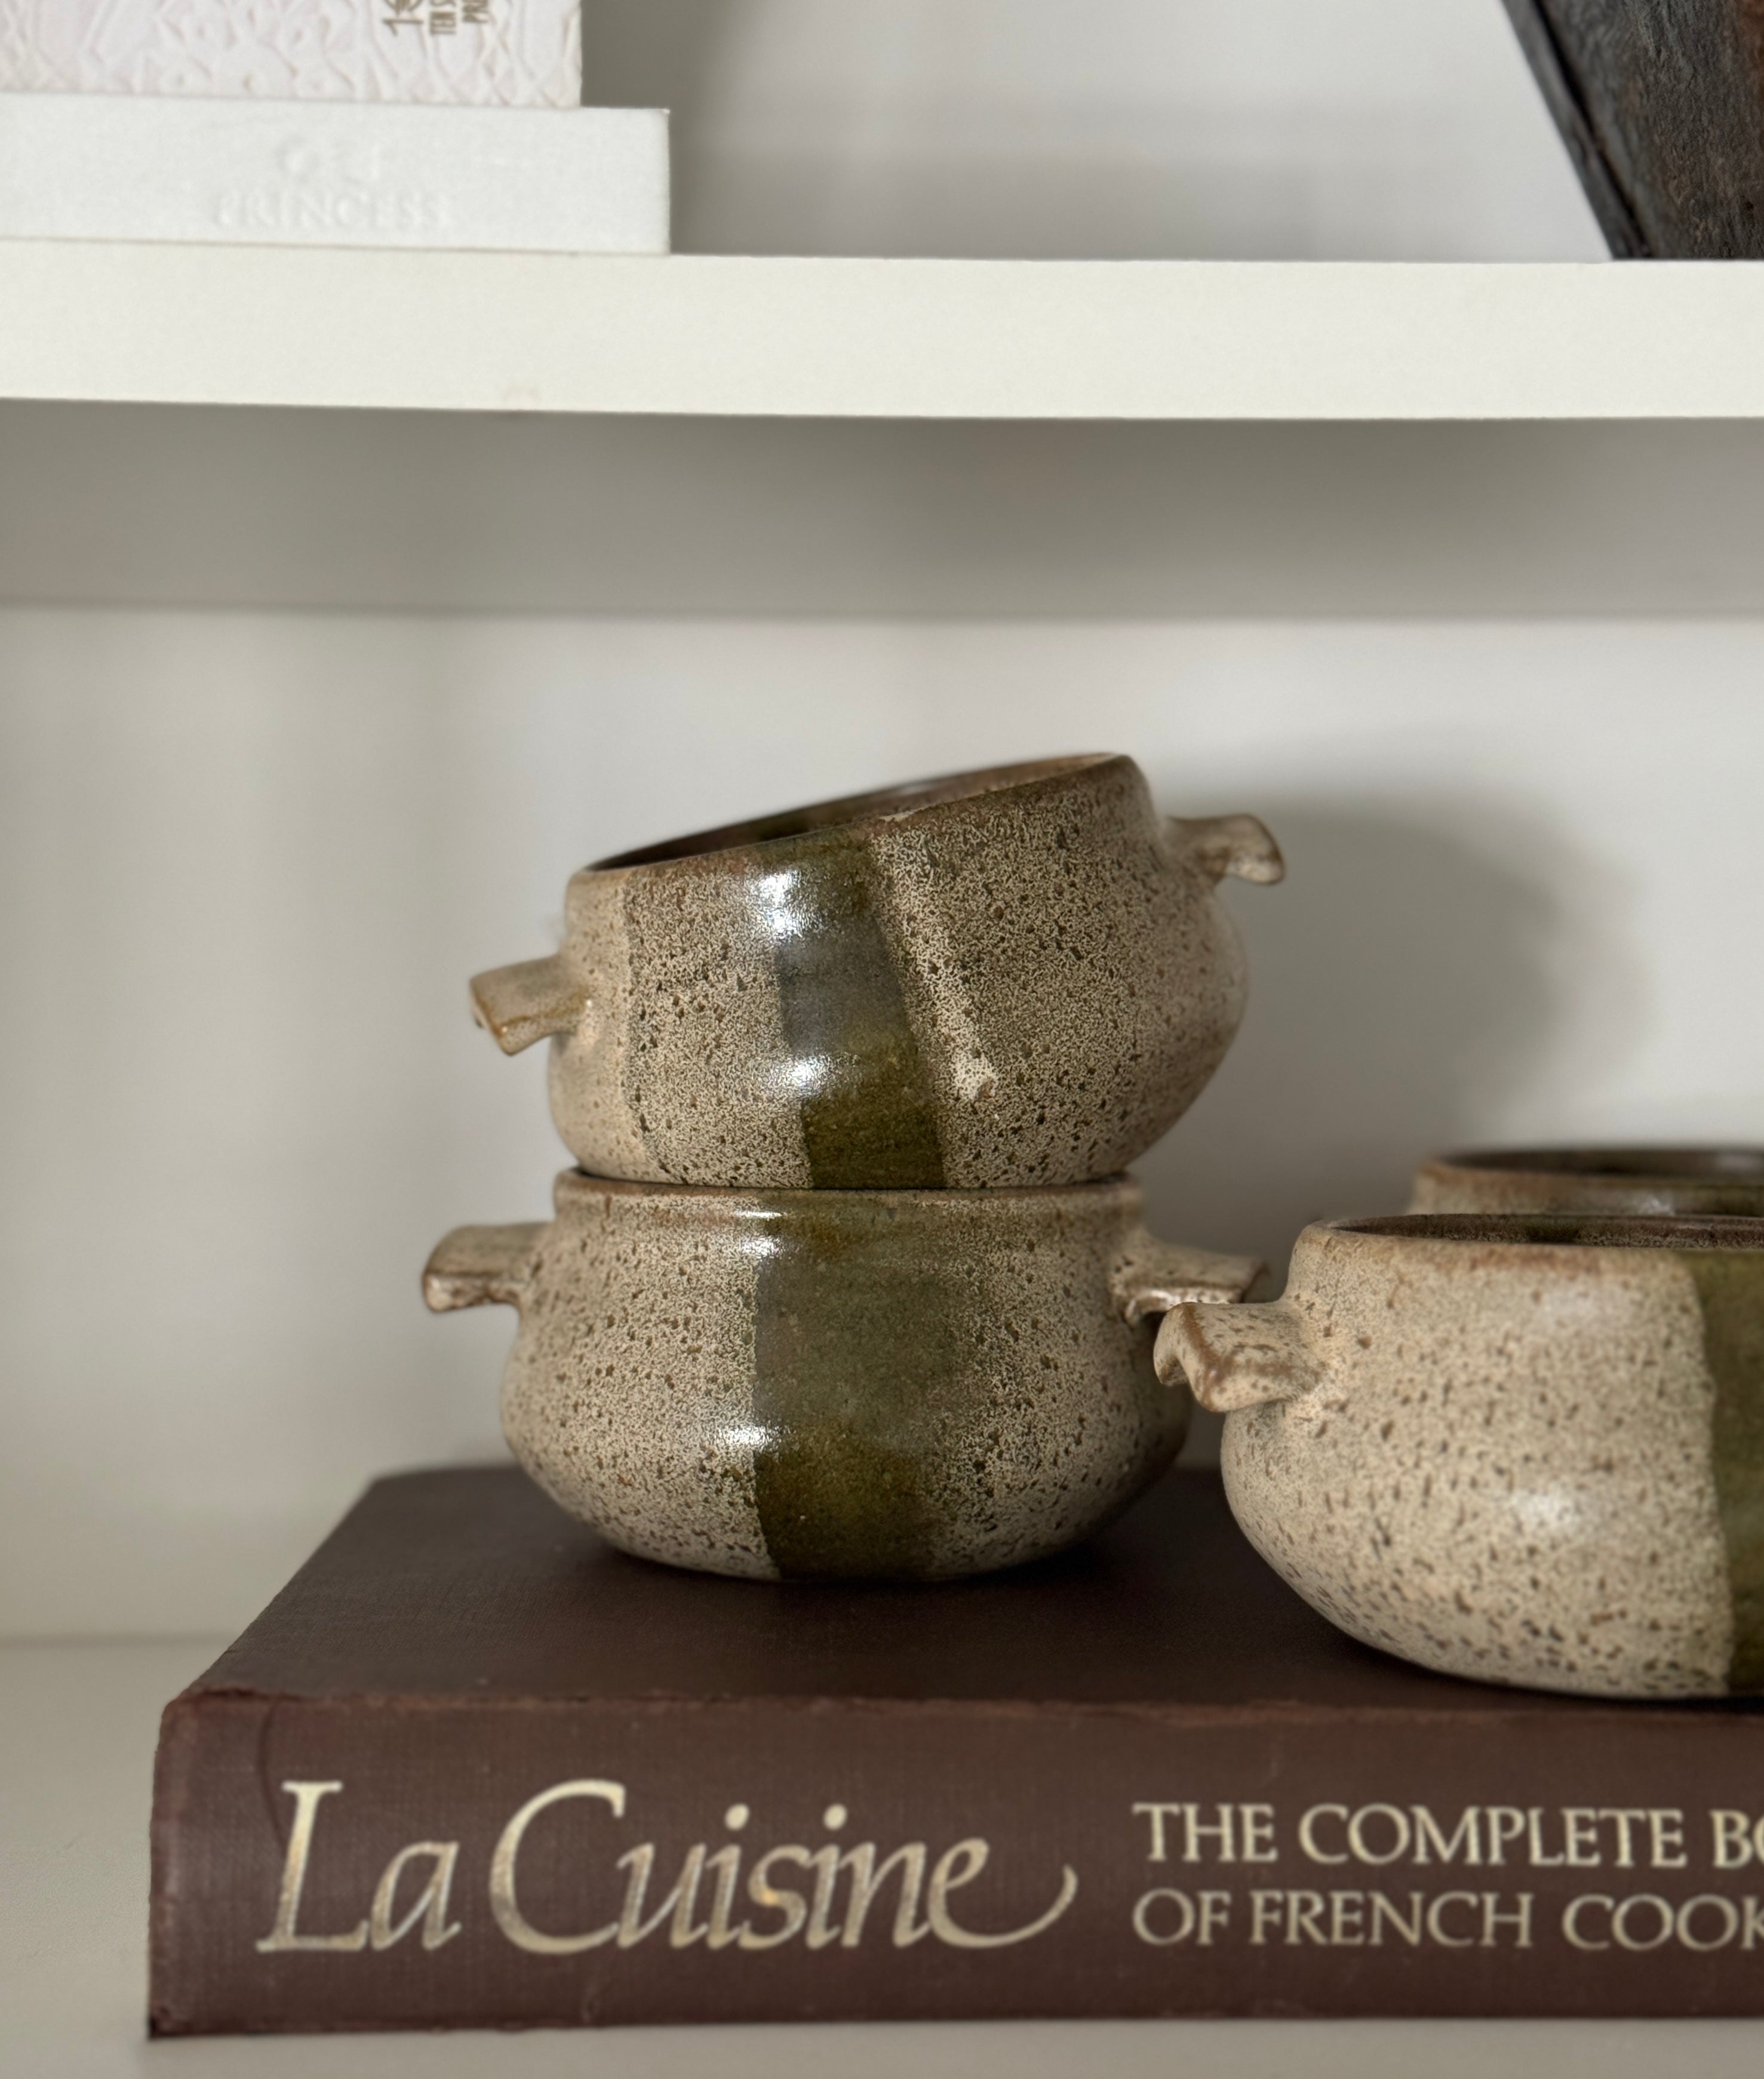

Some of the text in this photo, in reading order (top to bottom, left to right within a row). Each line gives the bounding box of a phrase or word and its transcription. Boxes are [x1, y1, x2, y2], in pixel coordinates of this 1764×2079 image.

[429, 11, 457, 35] TEN
[209, 186, 453, 230] PRINCESS
[256, 1778, 1078, 1954] La Cuisine
[1132, 1803, 1764, 1869] THE COMPLETE B
[1133, 1887, 1231, 1946] OF
[1249, 1890, 1534, 1947] FRENCH
